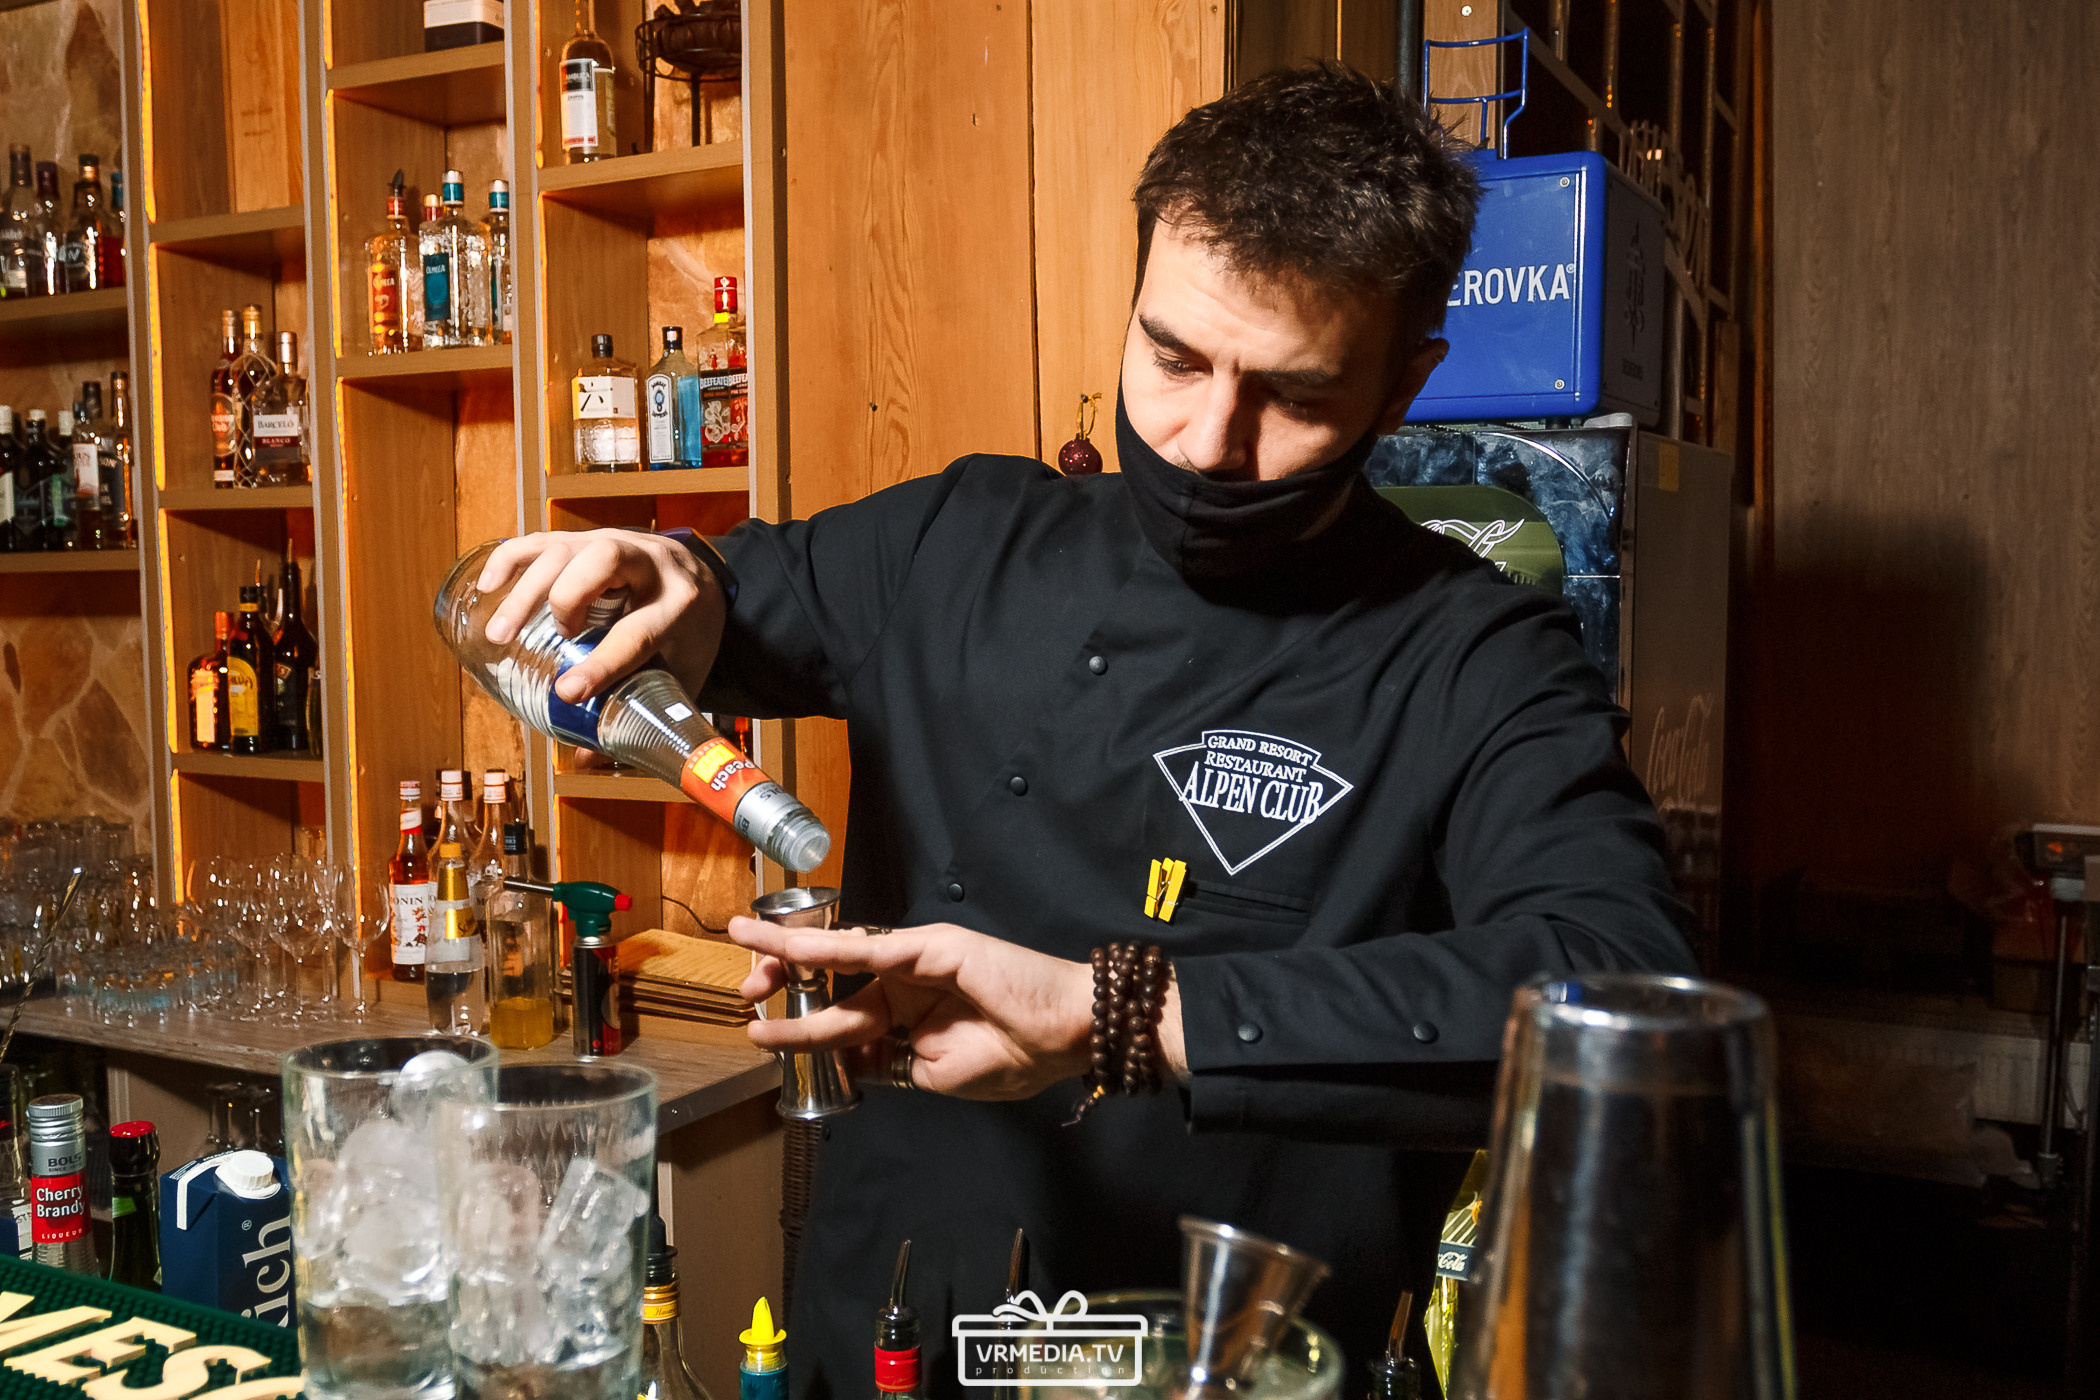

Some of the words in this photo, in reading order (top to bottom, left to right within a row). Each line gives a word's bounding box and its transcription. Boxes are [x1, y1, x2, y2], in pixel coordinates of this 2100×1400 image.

[1203, 751, 1307, 783] RESTAURANT
[1207, 735, 1257, 752] GRAND
[1258, 741, 1313, 767] RESORT
[710, 758, 757, 792] Peach
[1179, 761, 1261, 813] ALPEN
[1260, 780, 1324, 825] CLUB
[391, 896, 423, 906] ONIN
[48, 1154, 82, 1168] BOLS
[36, 1185, 84, 1202] Cherry
[36, 1199, 85, 1218] Brandy
[241, 1216, 291, 1329] ich
